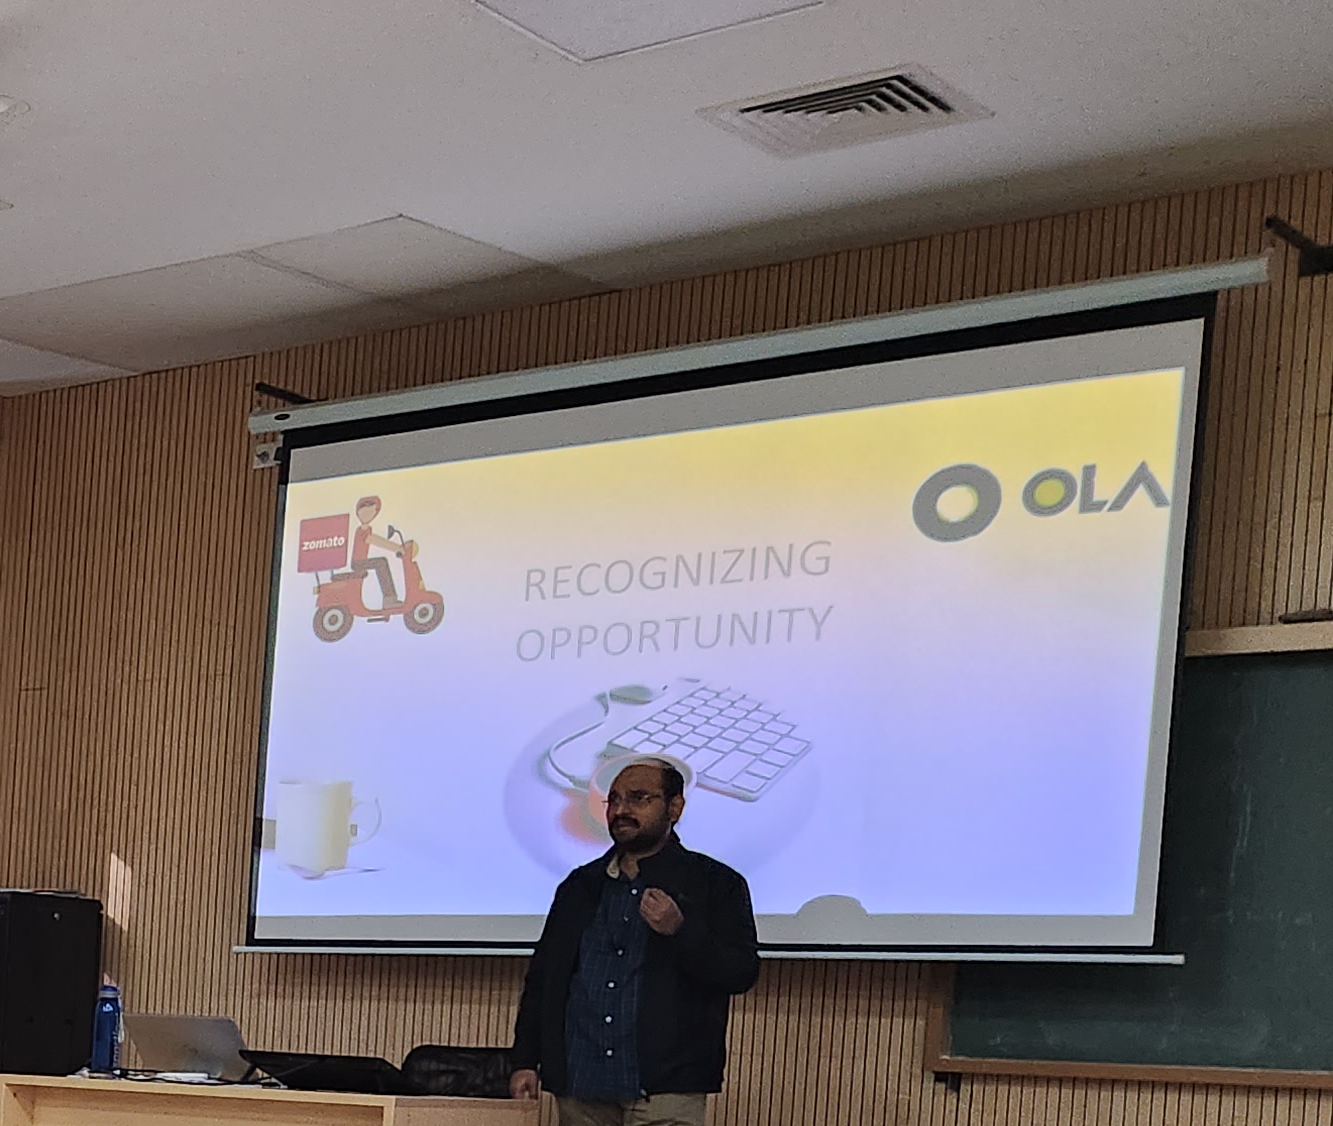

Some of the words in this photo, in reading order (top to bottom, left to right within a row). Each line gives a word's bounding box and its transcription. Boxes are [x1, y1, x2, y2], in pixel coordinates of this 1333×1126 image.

[1021, 460, 1171, 518] OLA
[302, 536, 346, 551] zomato
[524, 540, 832, 602] RECOGNIZING
[516, 604, 834, 662] OPPORTUNITY
